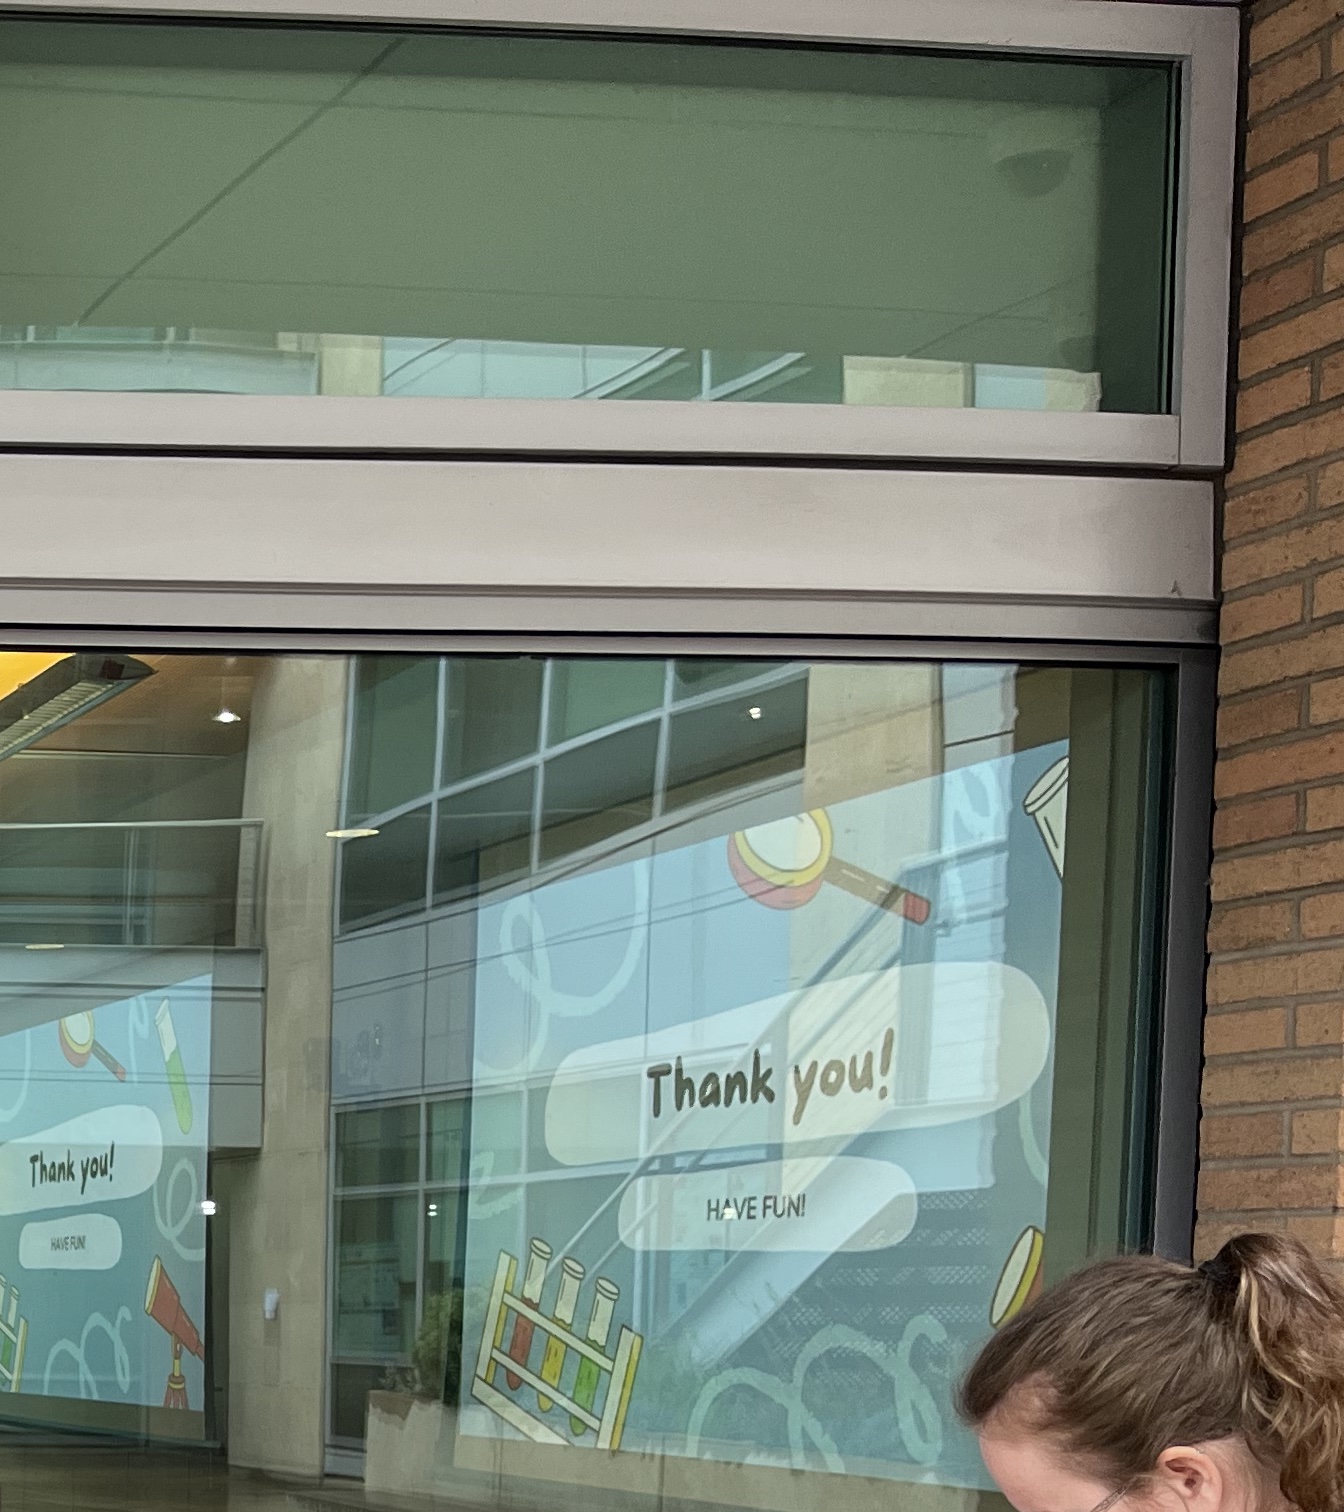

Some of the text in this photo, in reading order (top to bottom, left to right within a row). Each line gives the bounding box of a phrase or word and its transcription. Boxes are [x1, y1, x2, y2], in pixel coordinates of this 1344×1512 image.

[647, 1026, 896, 1127] Thank you!
[28, 1140, 116, 1196] Thank you!
[705, 1193, 806, 1222] HAVE FUN!
